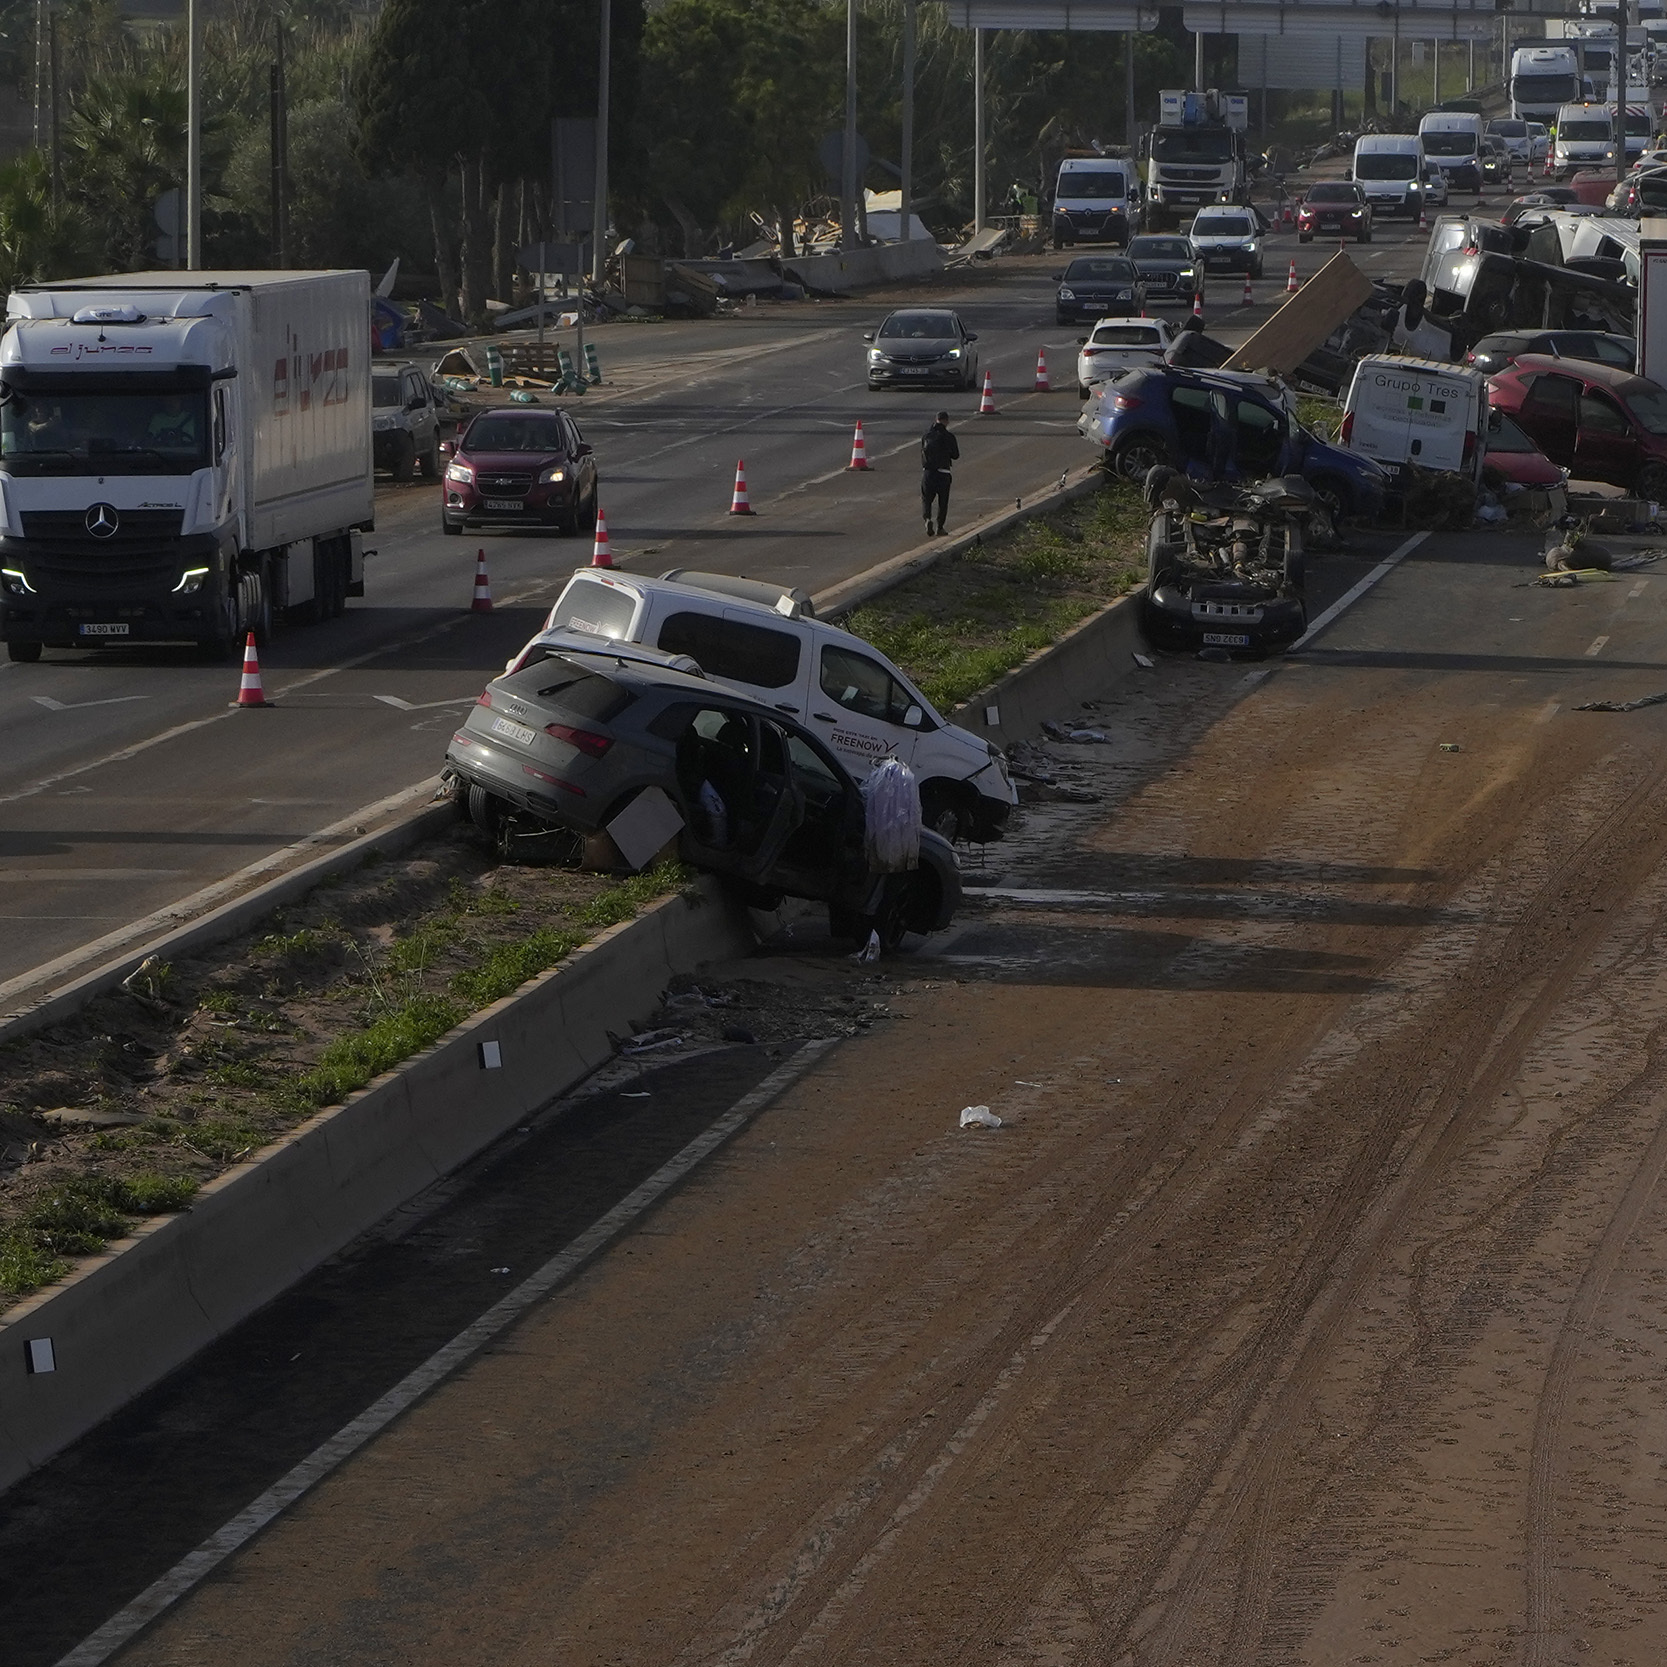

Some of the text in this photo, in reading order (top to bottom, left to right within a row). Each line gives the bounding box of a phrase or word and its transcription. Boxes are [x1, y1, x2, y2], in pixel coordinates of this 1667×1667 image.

[50, 343, 73, 354] el
[1375, 375, 1459, 399] Grupo Tres
[87, 624, 108, 634] 3490
[830, 733, 882, 752] FREENOW
